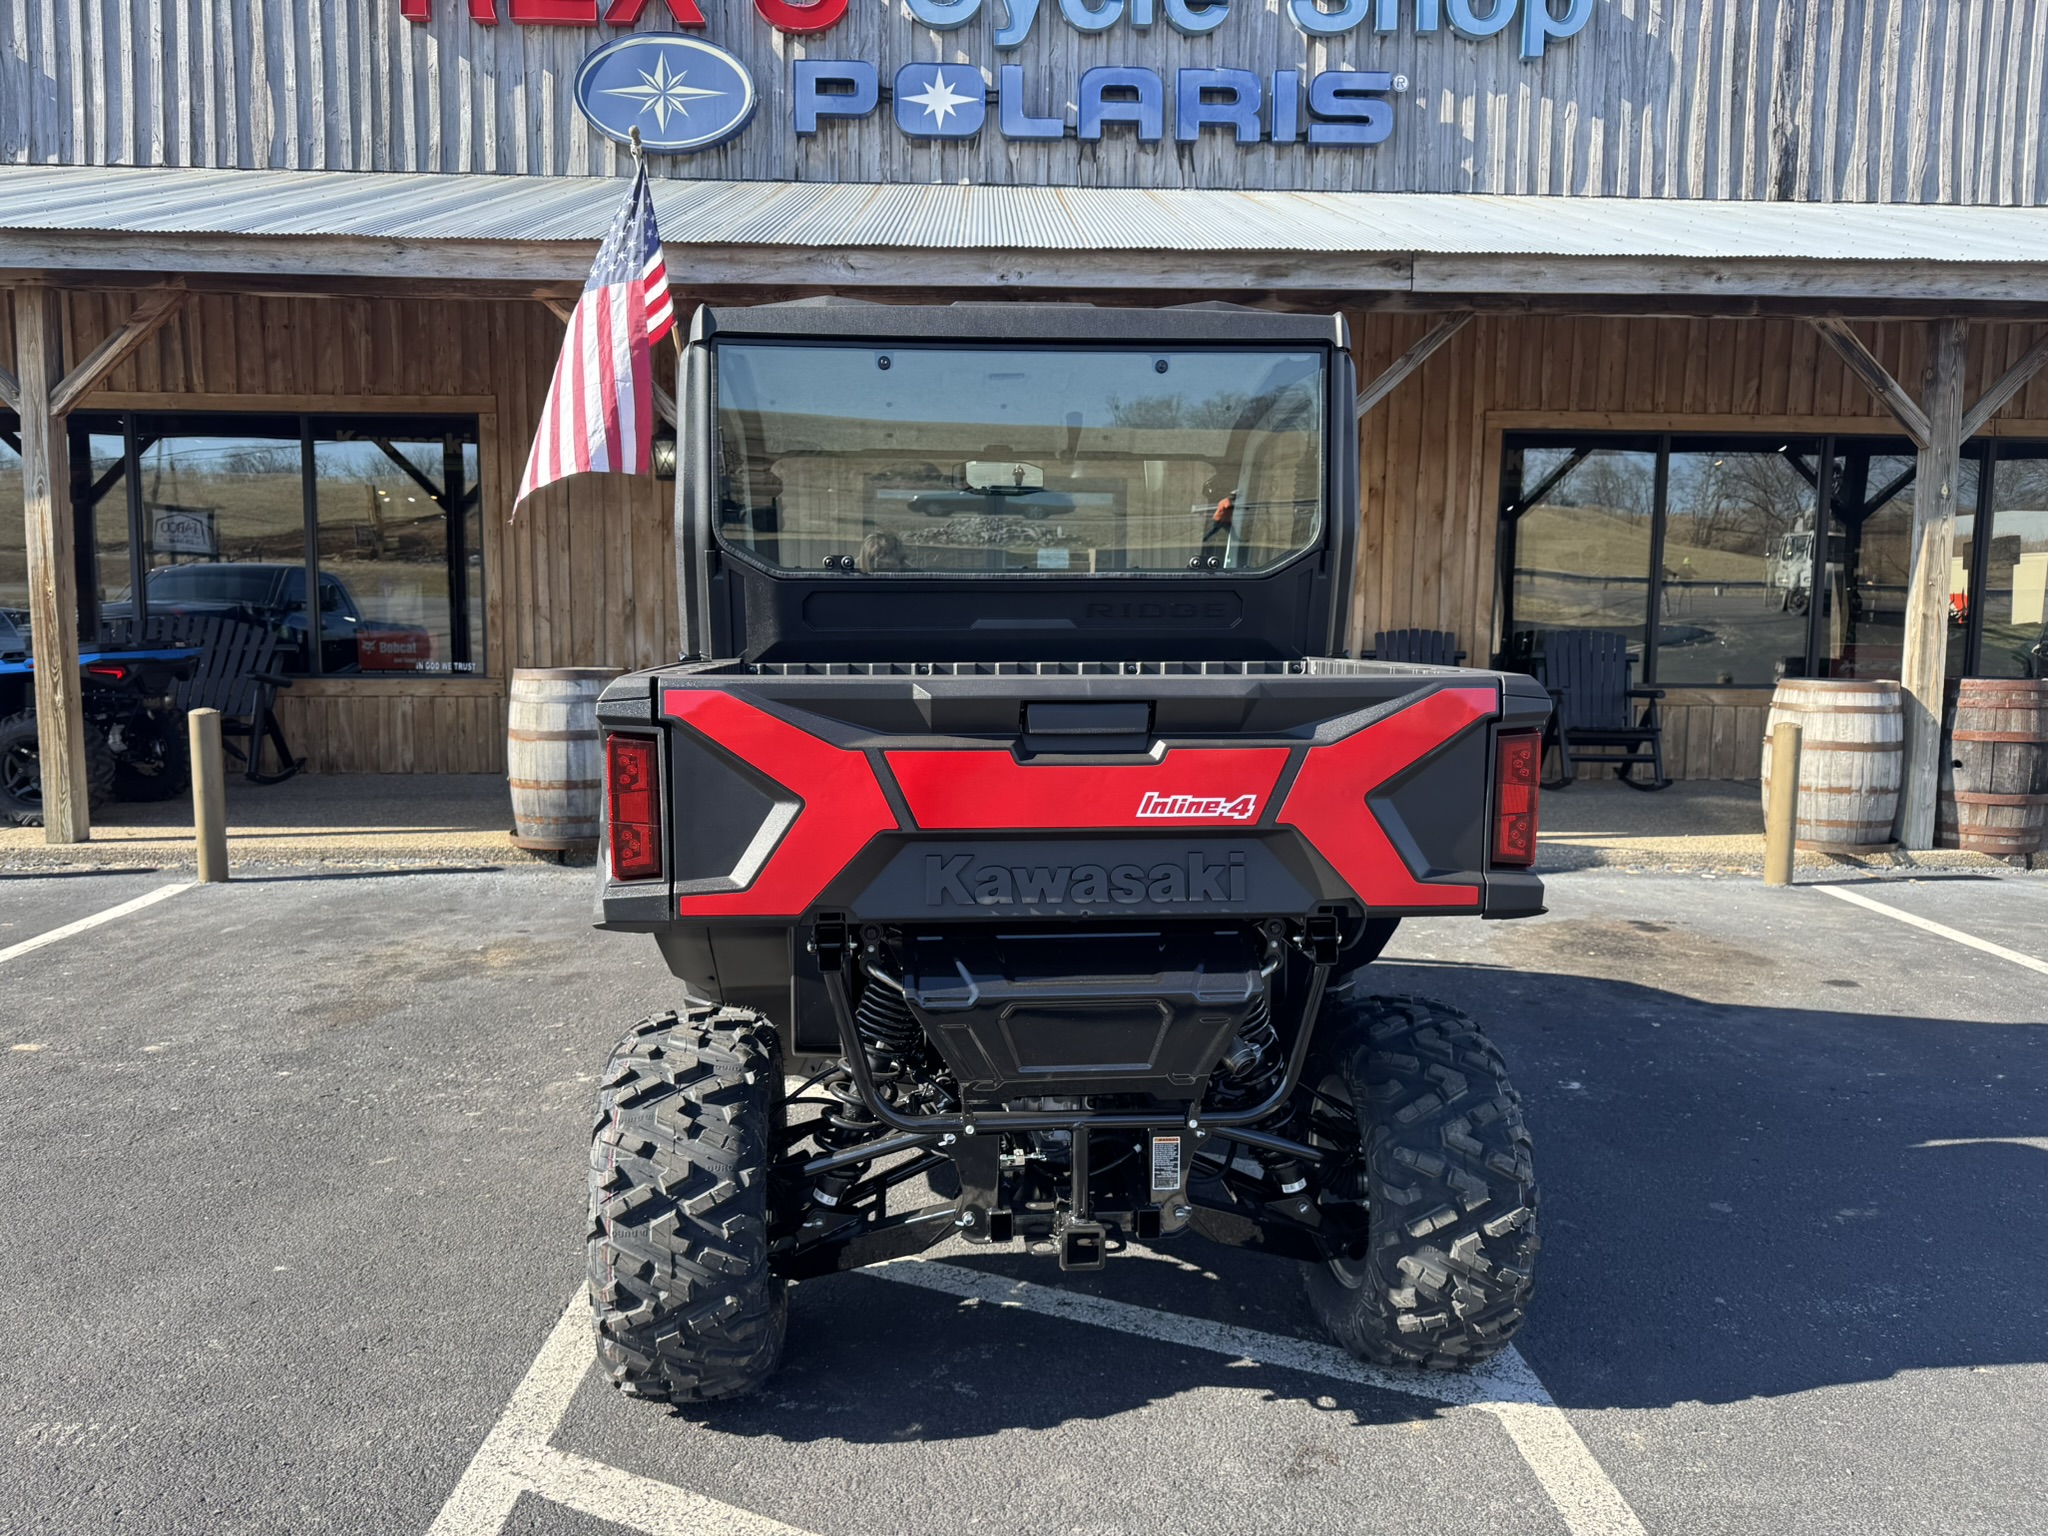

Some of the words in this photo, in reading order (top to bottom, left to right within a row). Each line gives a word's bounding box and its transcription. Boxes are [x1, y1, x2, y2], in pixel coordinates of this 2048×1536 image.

[1085, 602, 1225, 618] RIDGE
[379, 641, 417, 654] Bobcat
[416, 661, 424, 670] IN
[425, 661, 440, 671] GOD
[442, 662, 452, 670] WE
[453, 662, 477, 672] TRUST
[1136, 791, 1257, 820] Inline-4
[925, 851, 1247, 907] Kawasaki
